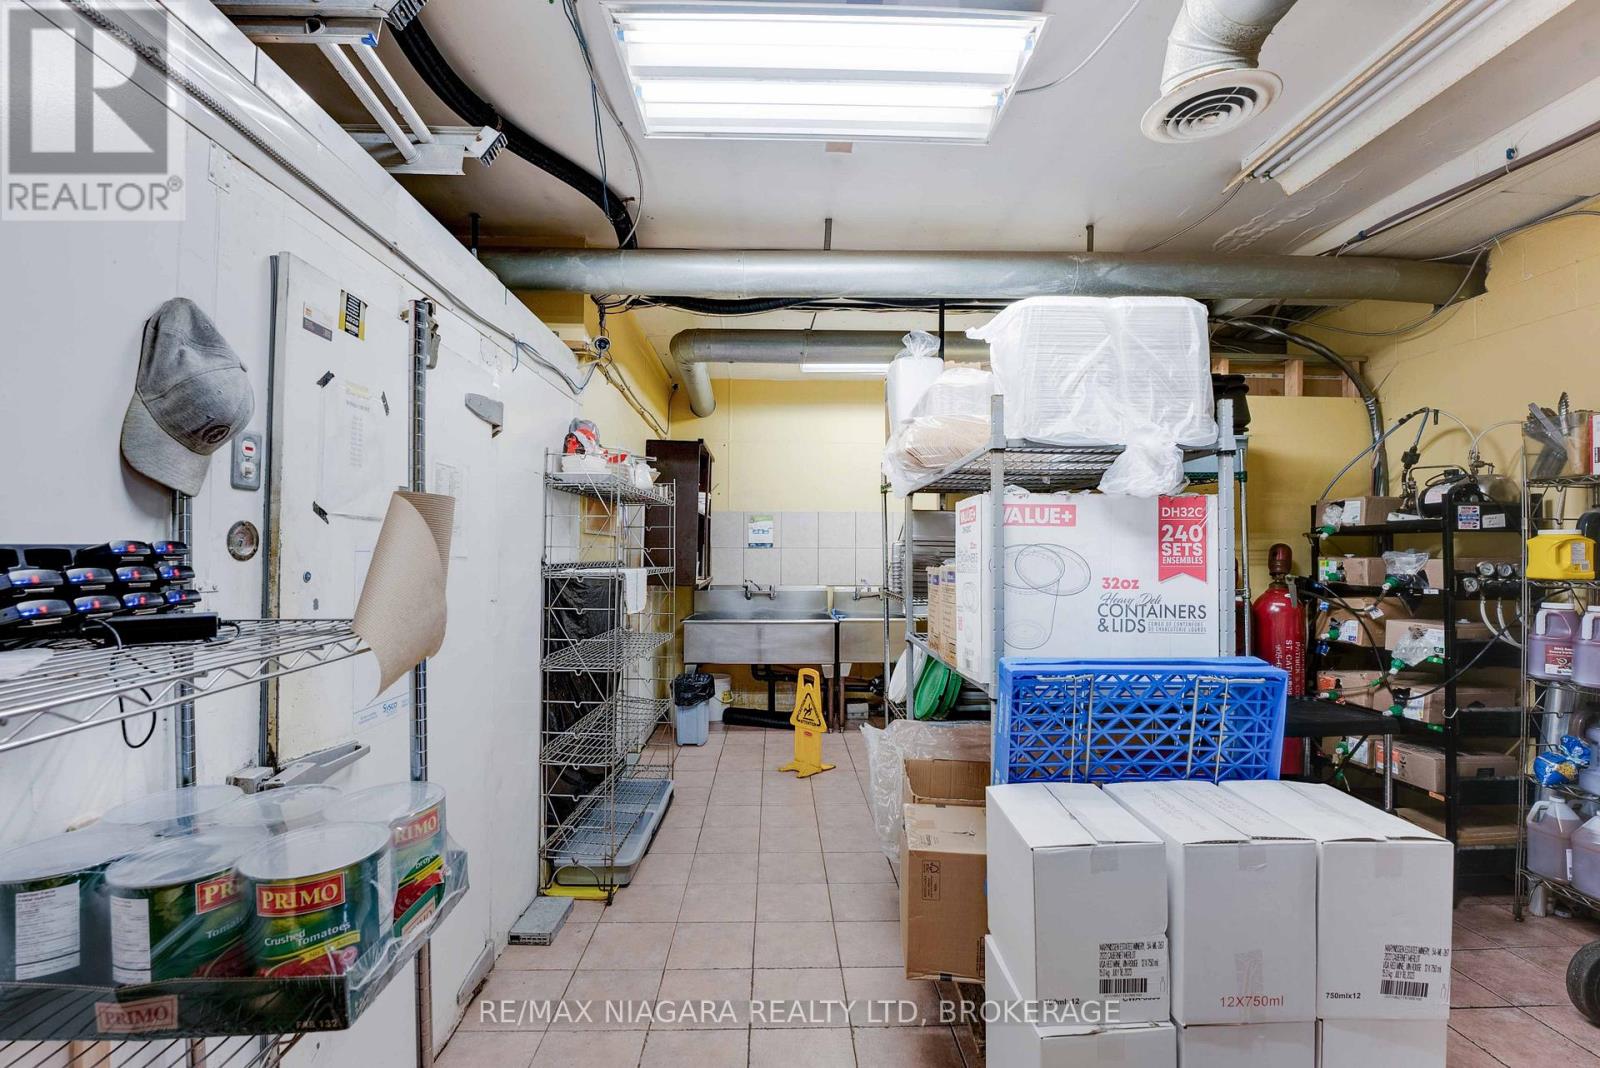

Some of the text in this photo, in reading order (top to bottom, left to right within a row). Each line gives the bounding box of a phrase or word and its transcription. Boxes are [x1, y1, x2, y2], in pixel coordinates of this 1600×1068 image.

[1161, 507, 1203, 518] DH32C
[1161, 525, 1202, 542] 240
[1161, 543, 1203, 556] SETS
[1162, 556, 1203, 565] ENSEMBLES
[1102, 577, 1140, 590] 32oz
[1097, 603, 1207, 620] CONTAINERS
[1097, 617, 1146, 633] & LIDS
[261, 883, 339, 910] PRIMO
[264, 928, 306, 947] Crushed
[297, 922, 352, 948] Tomatoes
[1219, 995, 1285, 1009] 12X750ml
[1326, 992, 1361, 1000] 750mlx12
[103, 1004, 169, 1026] PRIMO
